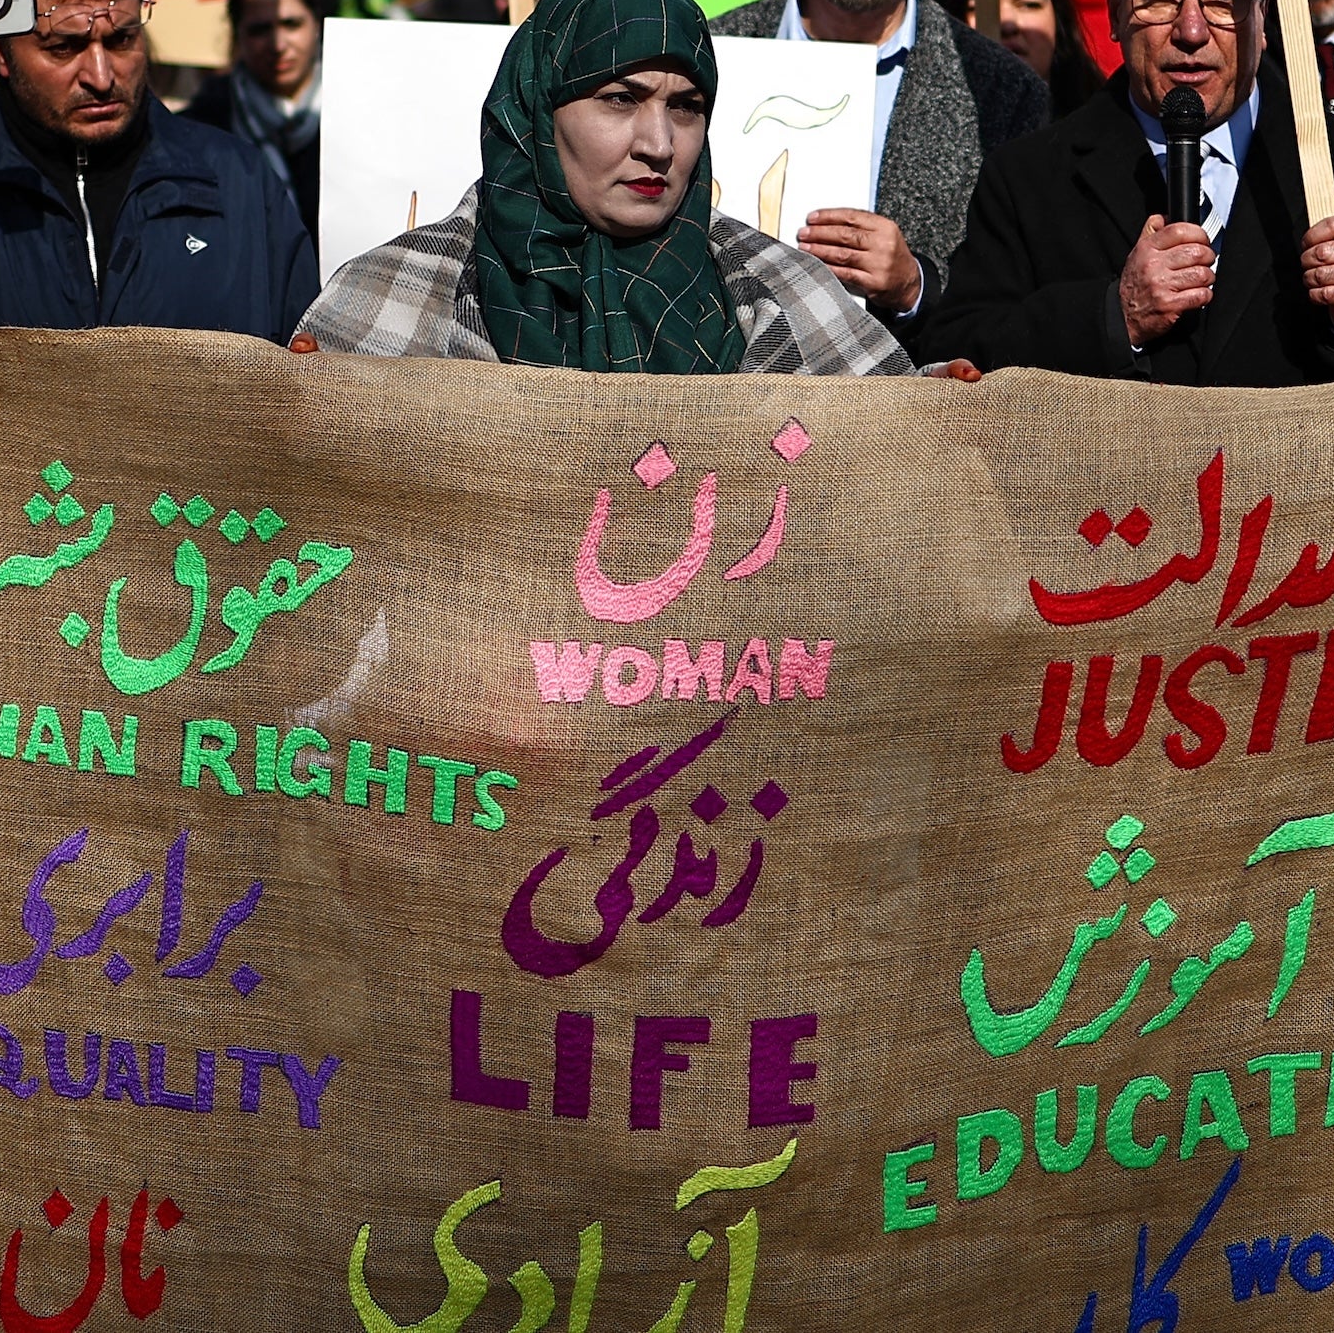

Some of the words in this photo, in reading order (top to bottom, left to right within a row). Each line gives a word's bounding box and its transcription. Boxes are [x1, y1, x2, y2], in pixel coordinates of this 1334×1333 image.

[101, 491, 354, 695] حقوق
[575, 417, 812, 624] زن
[529, 637, 835, 707] WOMAN
[180, 718, 519, 832] RIGHTS
[501, 708, 789, 979] زندگی
[450, 988, 818, 1132] LIFE
